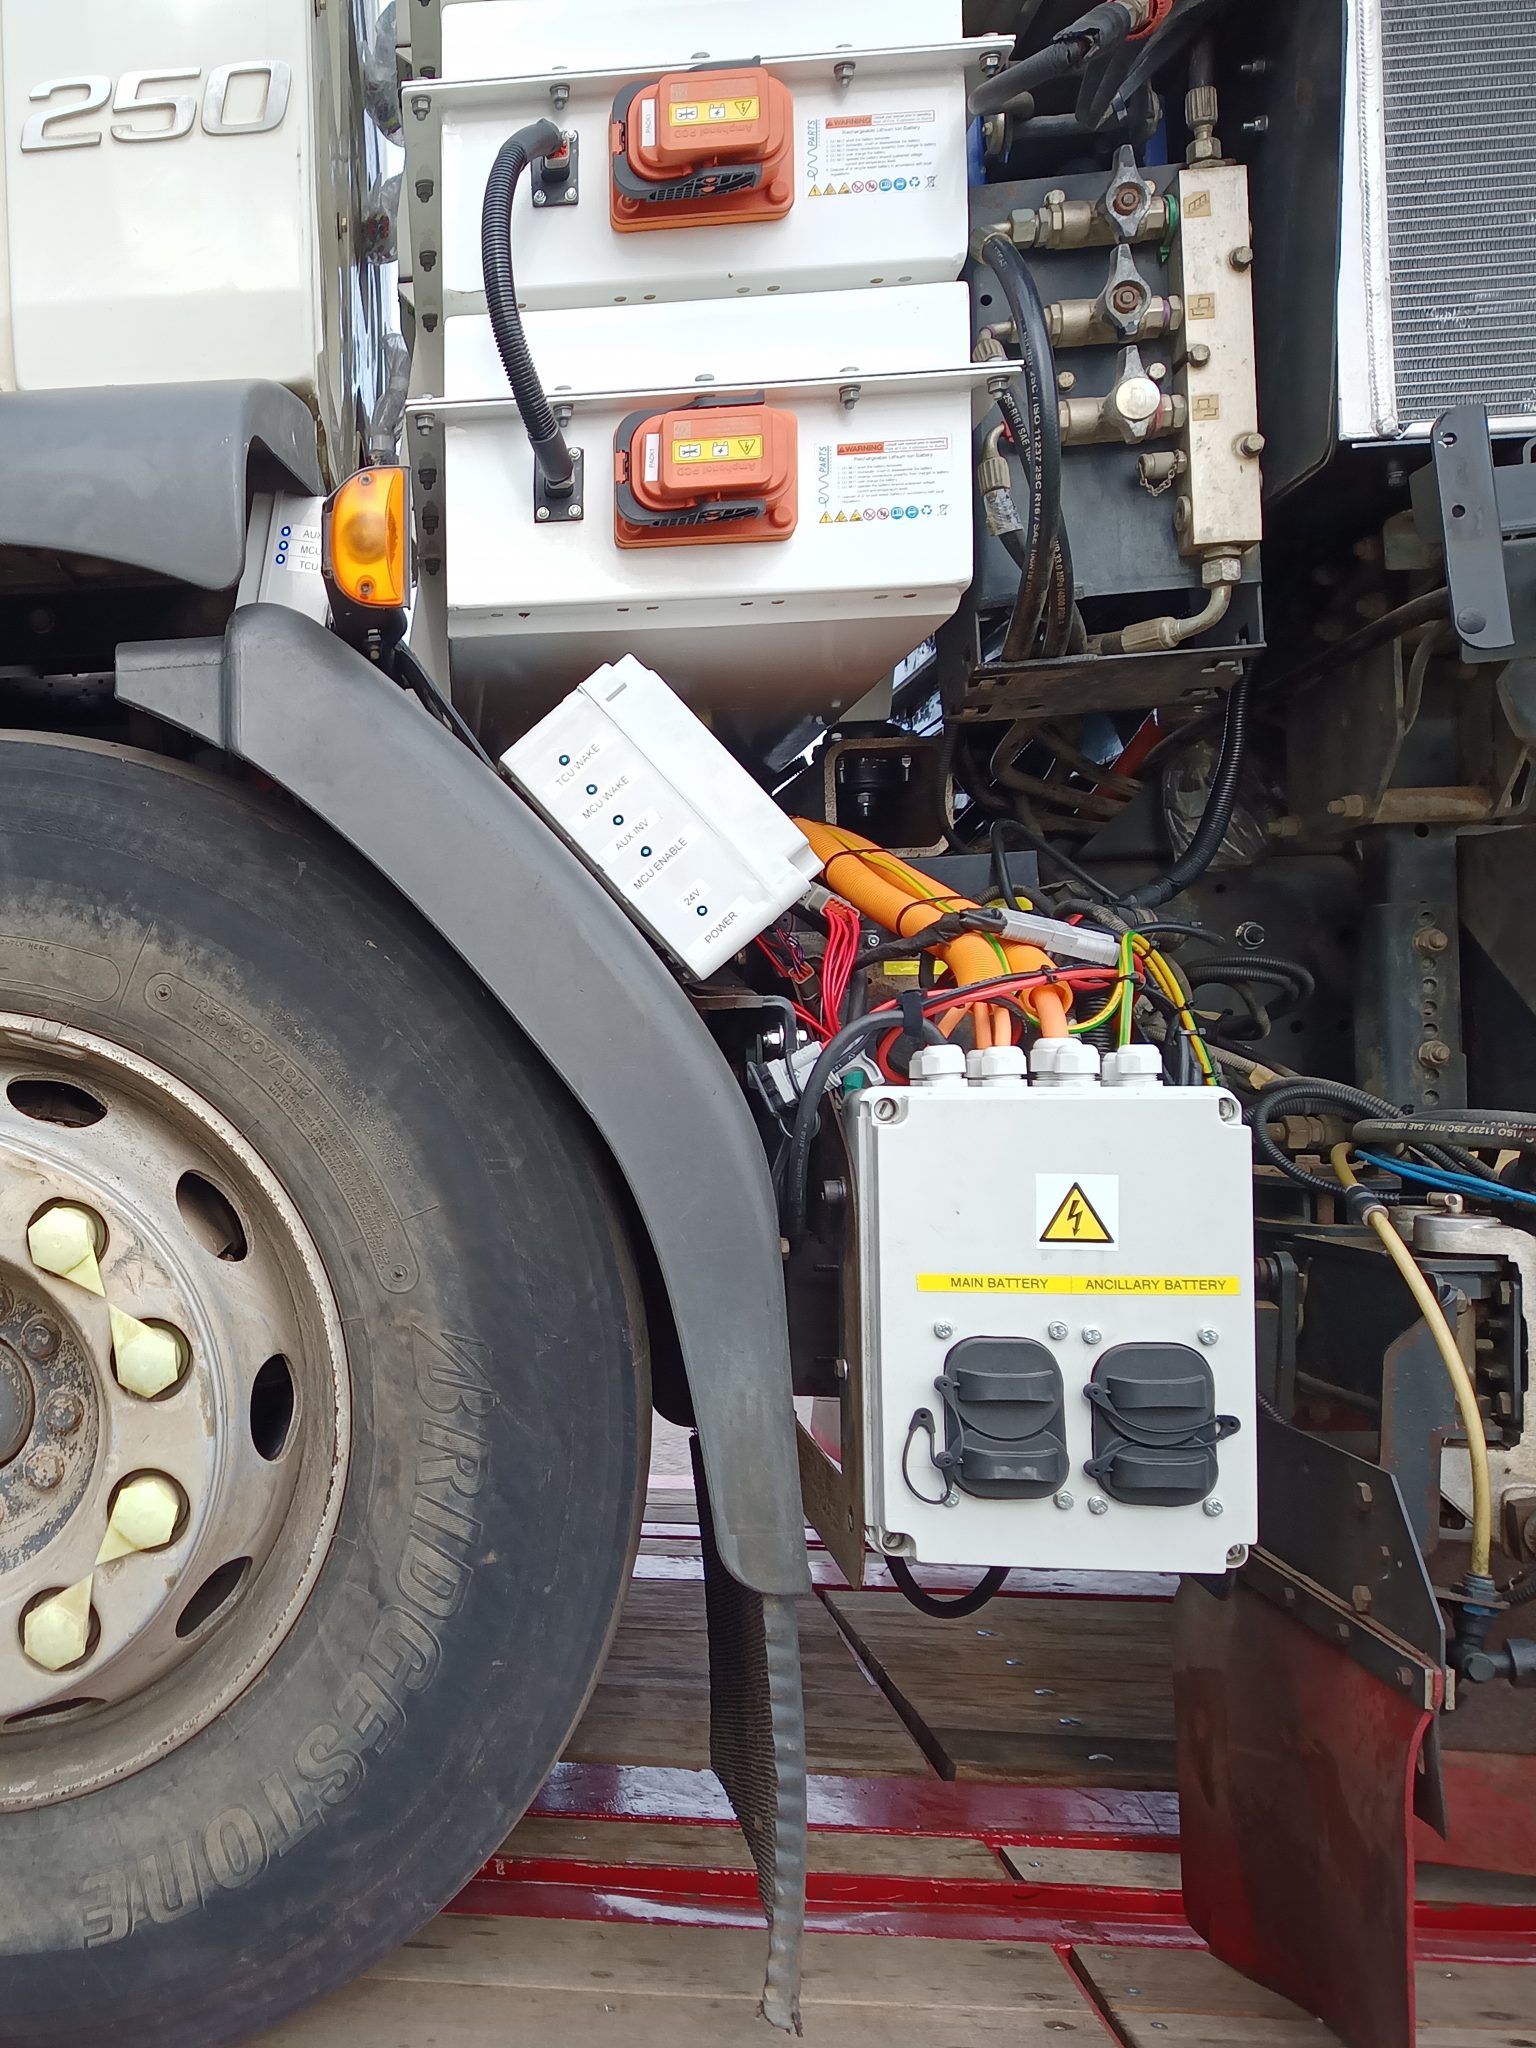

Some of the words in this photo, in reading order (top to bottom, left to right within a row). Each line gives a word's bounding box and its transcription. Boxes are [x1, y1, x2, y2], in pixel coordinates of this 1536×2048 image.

[20, 59, 291, 153] 250
[1010, 406, 1022, 424] R16
[1018, 427, 1031, 446] SAE
[1032, 402, 1041, 425] ISO
[845, 444, 884, 453] WARNING
[1034, 429, 1042, 462] 11237
[1034, 465, 1042, 490] 2SC
[300, 560, 319, 571] TCU
[556, 768, 575, 787] TCU
[574, 743, 600, 768] WAKE
[582, 798, 604, 820] MCU
[602, 775, 630, 800] WAKE
[615, 833, 634, 851] AUX
[632, 818, 649, 836] INV
[633, 869, 655, 890] MCU
[654, 836, 688, 870] ENABLE
[684, 888, 701, 906] 24V
[704, 910, 738, 944] POWER
[192, 997, 313, 1100] REGROOVABLE
[1408, 1122, 1425, 1130] SAE
[1447, 1124, 1466, 1133] 2SC
[1468, 1126, 1495, 1136] 11237
[1499, 1128, 1517, 1138] ISO
[950, 1278, 985, 1288] MAIN
[987, 1278, 1048, 1289] BATTERY
[1086, 1279, 1159, 1290] ANCILLARY
[1164, 1279, 1226, 1290] BATTERY
[81, 1323, 498, 1948] BRIDGESTONE
